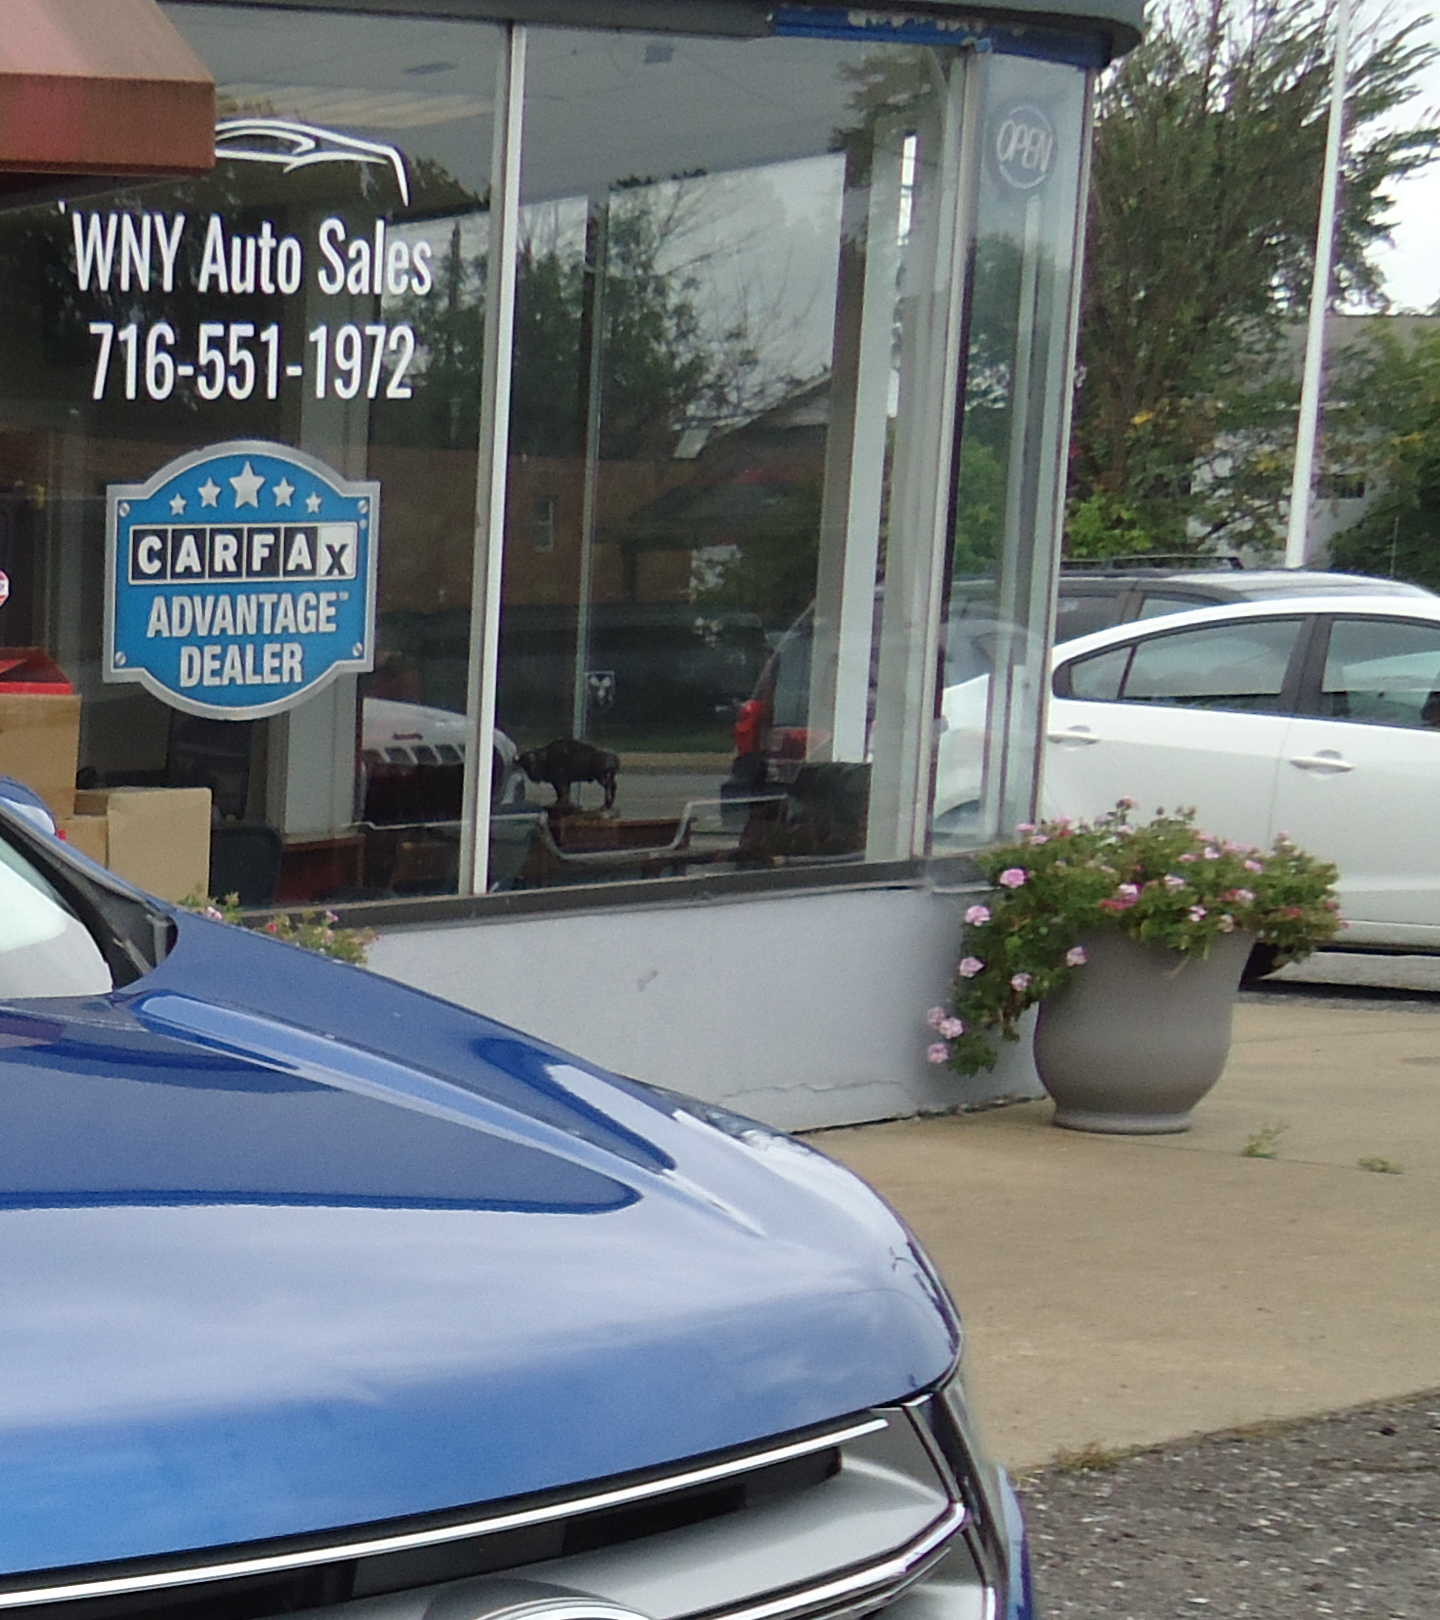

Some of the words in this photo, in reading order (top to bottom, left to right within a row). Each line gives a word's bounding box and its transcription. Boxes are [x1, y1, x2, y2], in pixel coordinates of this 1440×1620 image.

[996, 118, 1052, 172] OPEN
[72, 213, 184, 292] WNY
[197, 215, 302, 294] Auto
[318, 218, 433, 296] Sales
[88, 323, 415, 400] 716-551-1972
[137, 532, 349, 577] CARFAX
[146, 591, 337, 638] ADVANTAGE
[180, 642, 303, 688] DEALER
